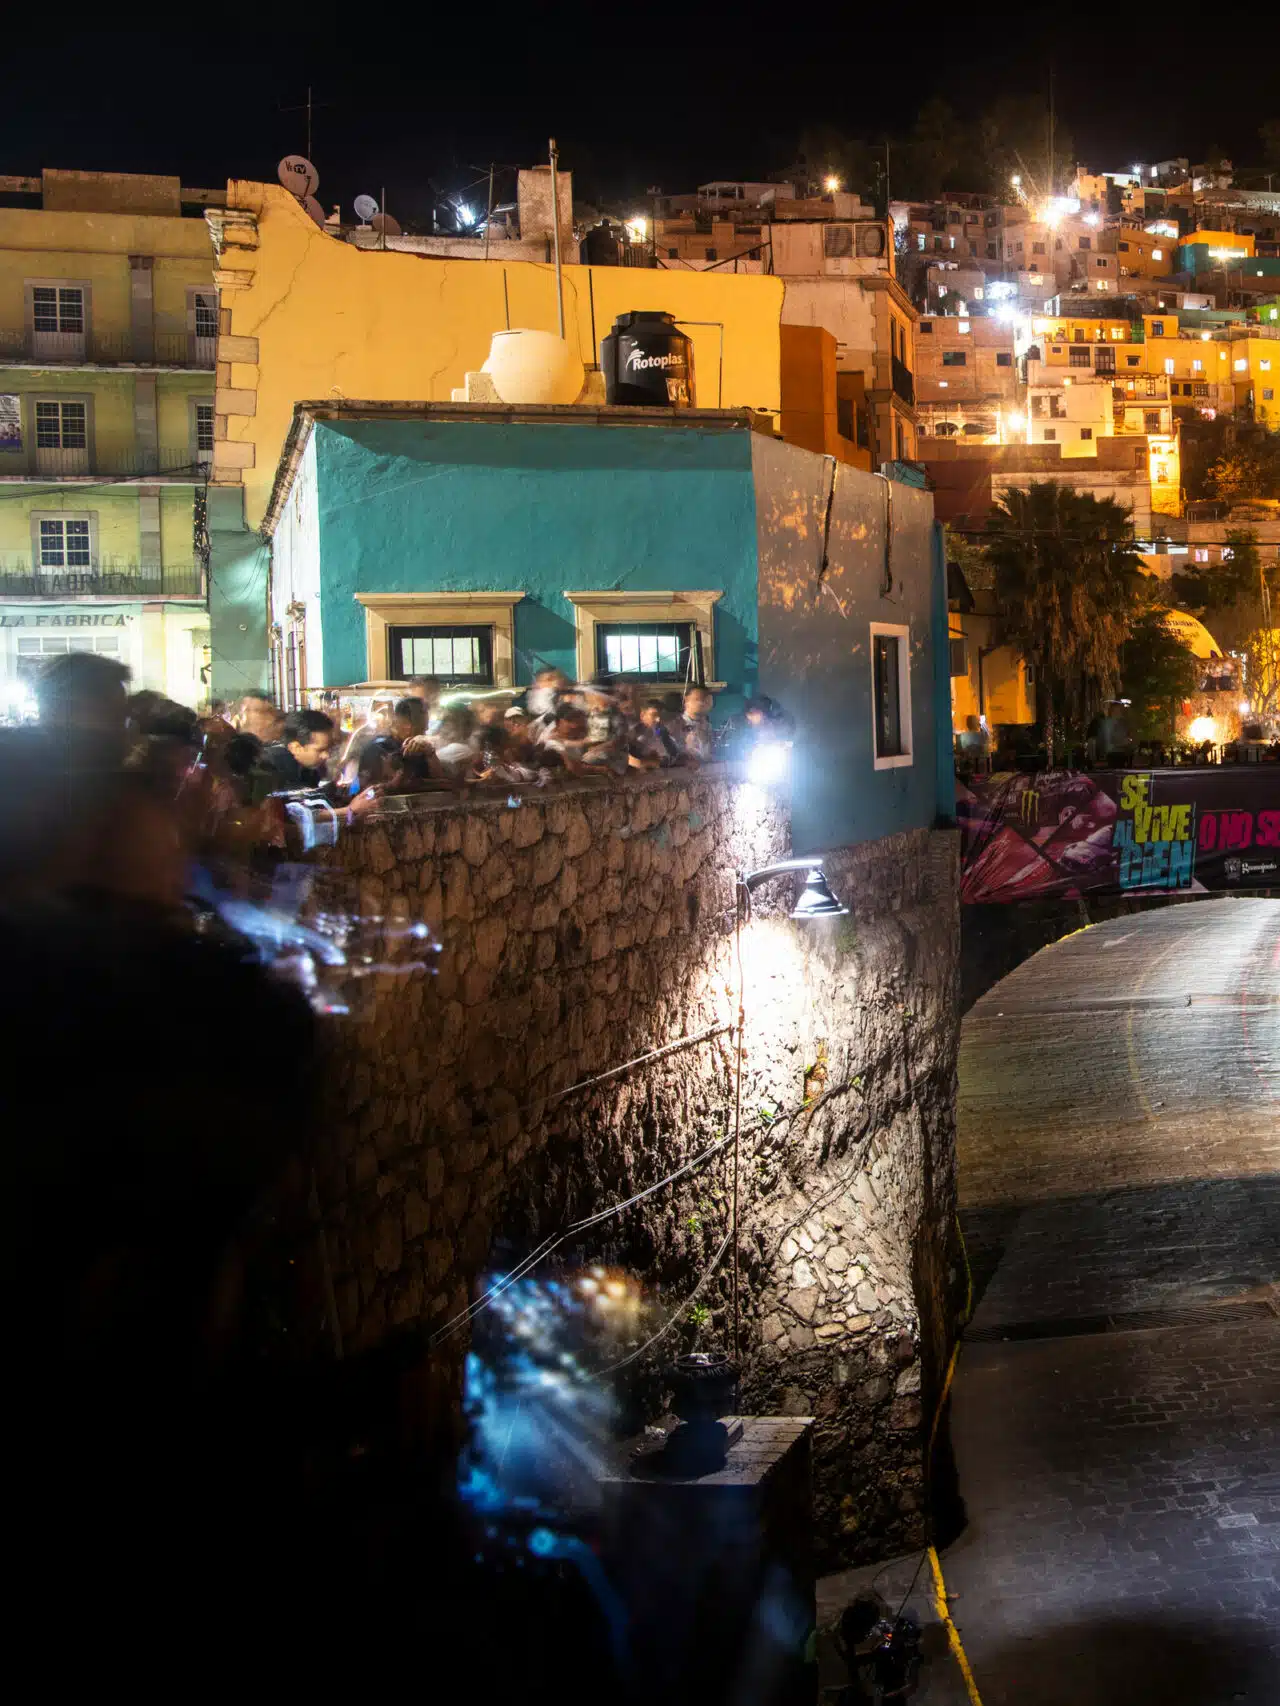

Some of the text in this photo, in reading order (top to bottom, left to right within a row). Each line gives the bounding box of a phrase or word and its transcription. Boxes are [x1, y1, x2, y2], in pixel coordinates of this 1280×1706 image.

[632, 353, 683, 371] Rotoplas
[0, 615, 25, 627] LA
[1120, 774, 1151, 811] SE
[1217, 812, 1253, 850] NO
